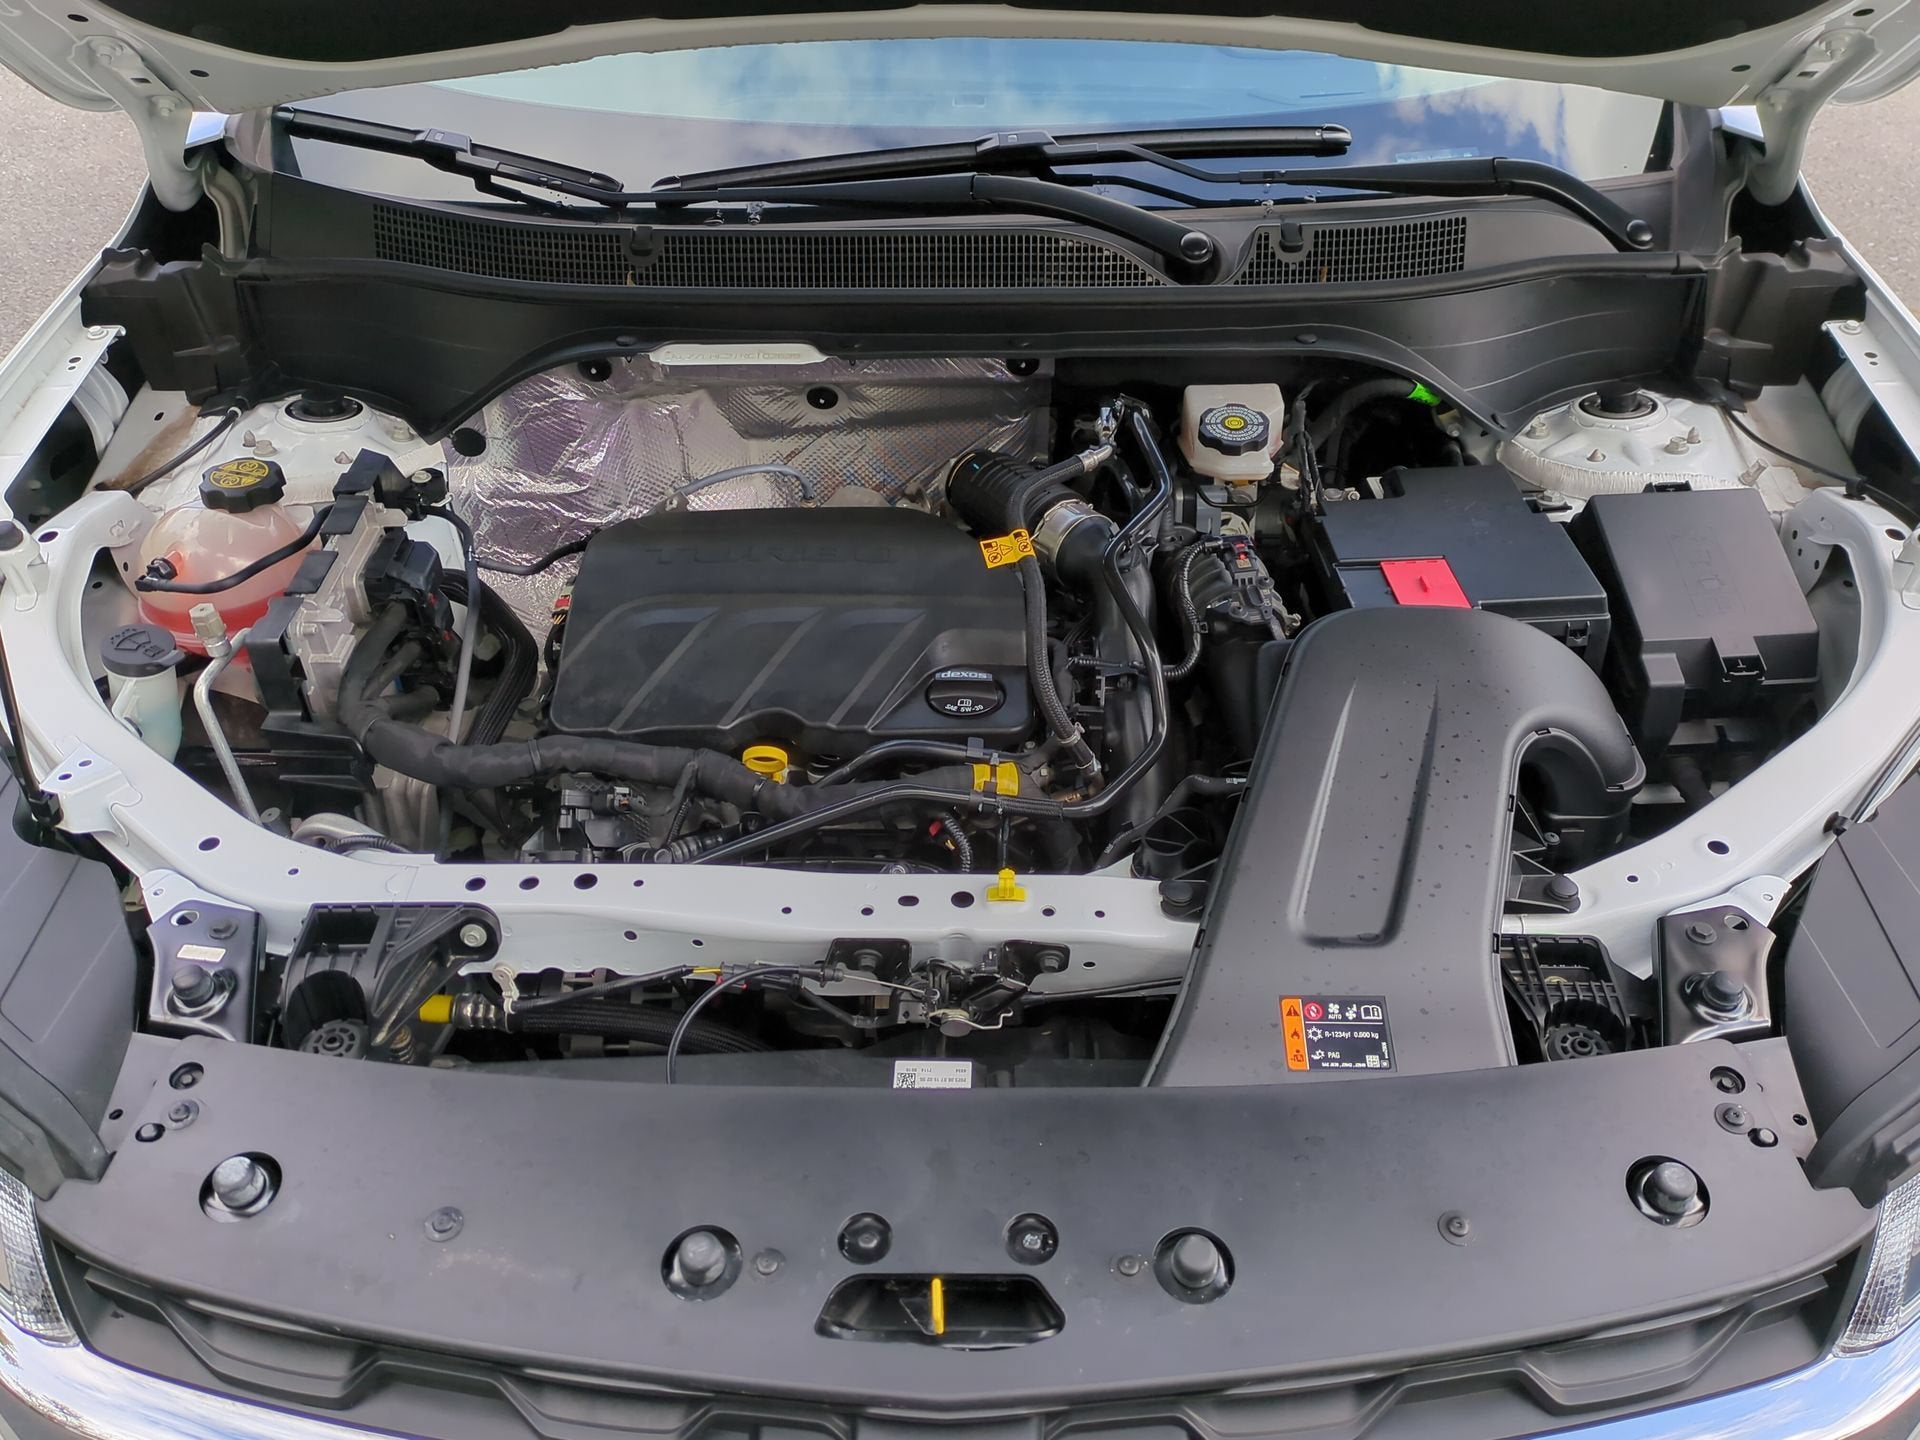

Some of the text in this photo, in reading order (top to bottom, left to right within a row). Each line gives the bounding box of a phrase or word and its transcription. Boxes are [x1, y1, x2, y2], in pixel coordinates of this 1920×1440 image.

[645, 543, 898, 564] TURBO
[941, 670, 988, 679] dexos
[1324, 1031, 1351, 1039] R-1234yf
[1371, 1031, 1379, 1039] kg
[1327, 1051, 1341, 1059] PAG
